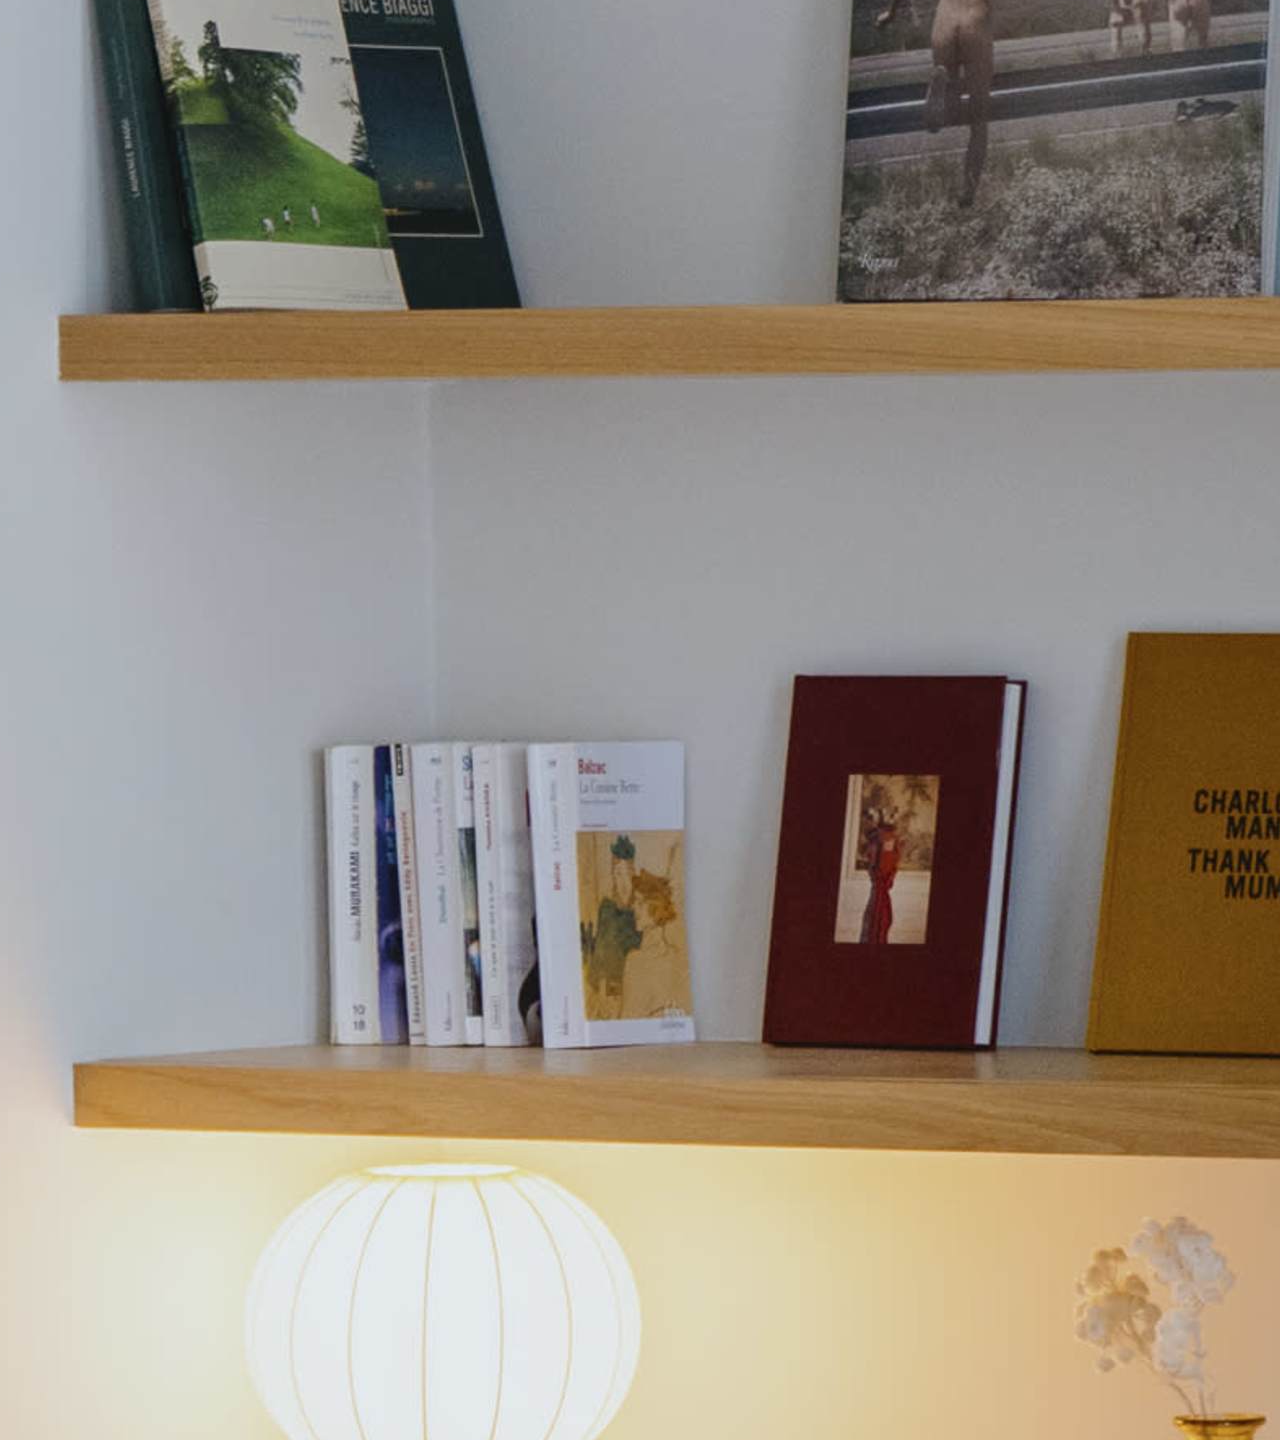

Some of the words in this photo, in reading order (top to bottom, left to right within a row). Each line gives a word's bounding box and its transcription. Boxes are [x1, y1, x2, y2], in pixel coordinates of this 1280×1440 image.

[577, 758, 607, 775] Balzac
[1188, 848, 1269, 873] THANK
[349, 851, 362, 919] MURAKAMI
